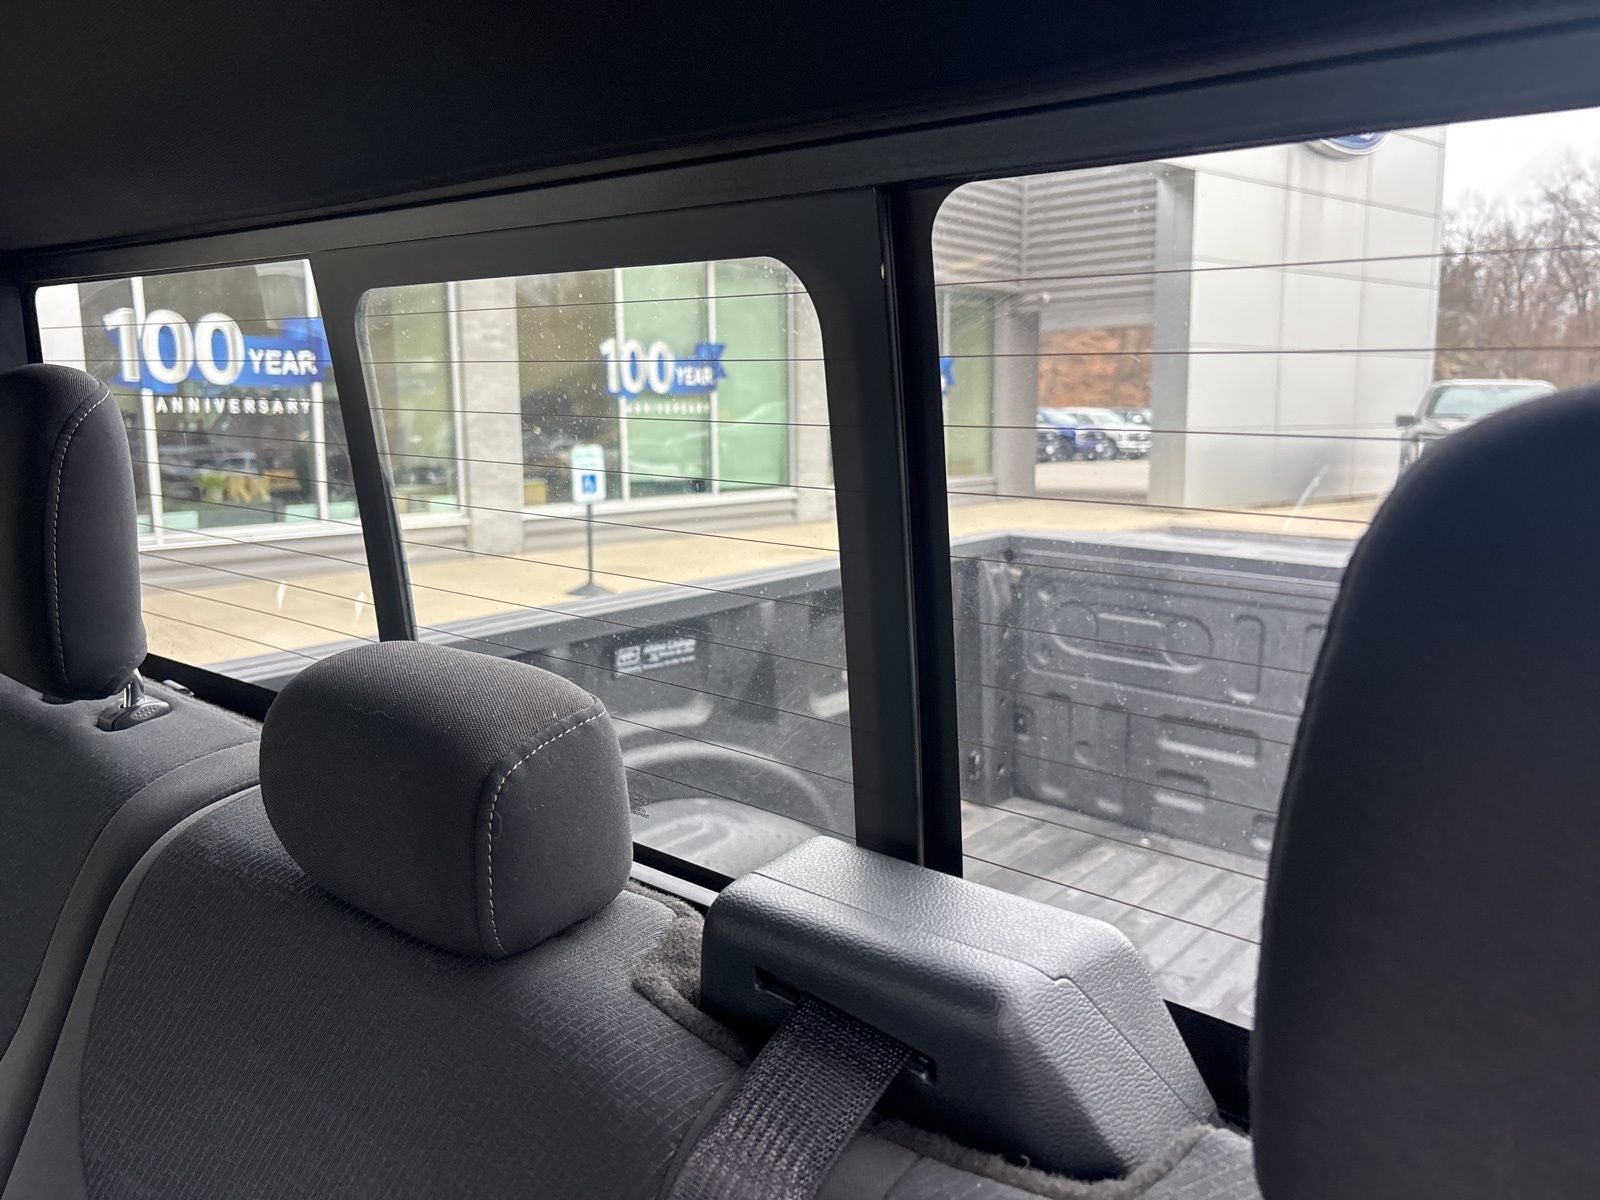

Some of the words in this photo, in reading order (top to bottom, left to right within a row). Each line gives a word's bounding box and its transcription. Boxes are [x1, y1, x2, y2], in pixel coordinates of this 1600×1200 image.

[103, 307, 244, 385] 100
[248, 349, 318, 376] YEAR
[600, 338, 675, 394] 100
[676, 367, 713, 386] YEAR
[155, 396, 312, 415] ANNIVERSARY
